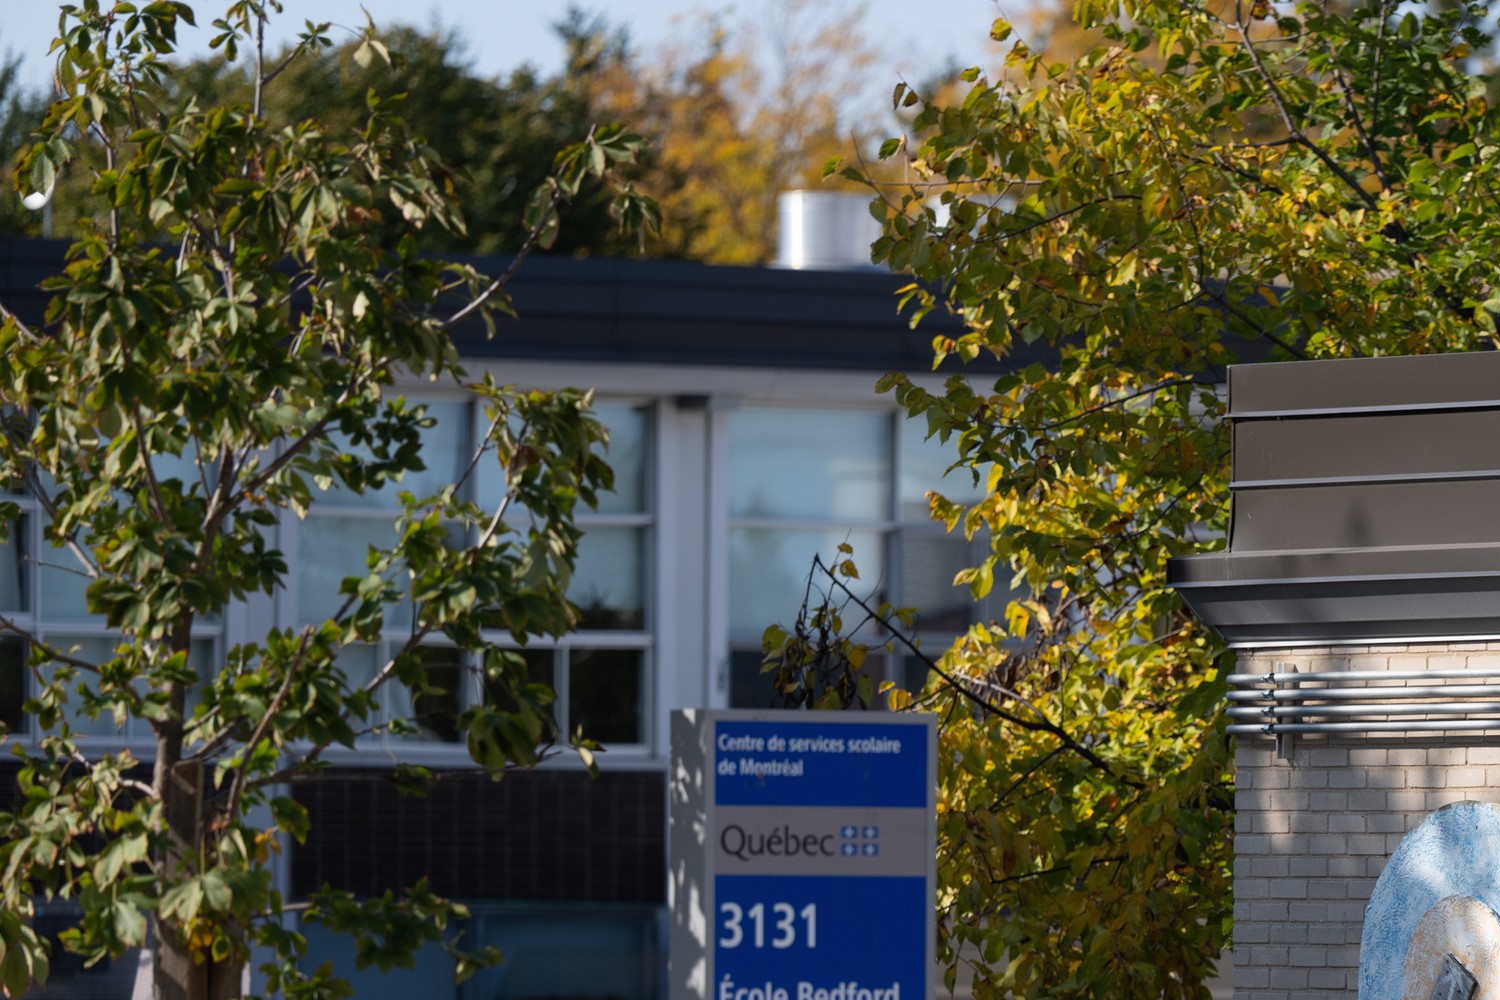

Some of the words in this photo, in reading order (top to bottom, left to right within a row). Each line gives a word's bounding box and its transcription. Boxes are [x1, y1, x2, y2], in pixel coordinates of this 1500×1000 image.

[718, 734, 765, 752] Centre
[767, 736, 786, 752] de
[789, 735, 844, 753] services
[847, 737, 902, 754] scolaire
[718, 759, 736, 775] de
[740, 759, 803, 776] Montréal
[720, 824, 835, 861] Québec
[720, 902, 817, 948] 3131
